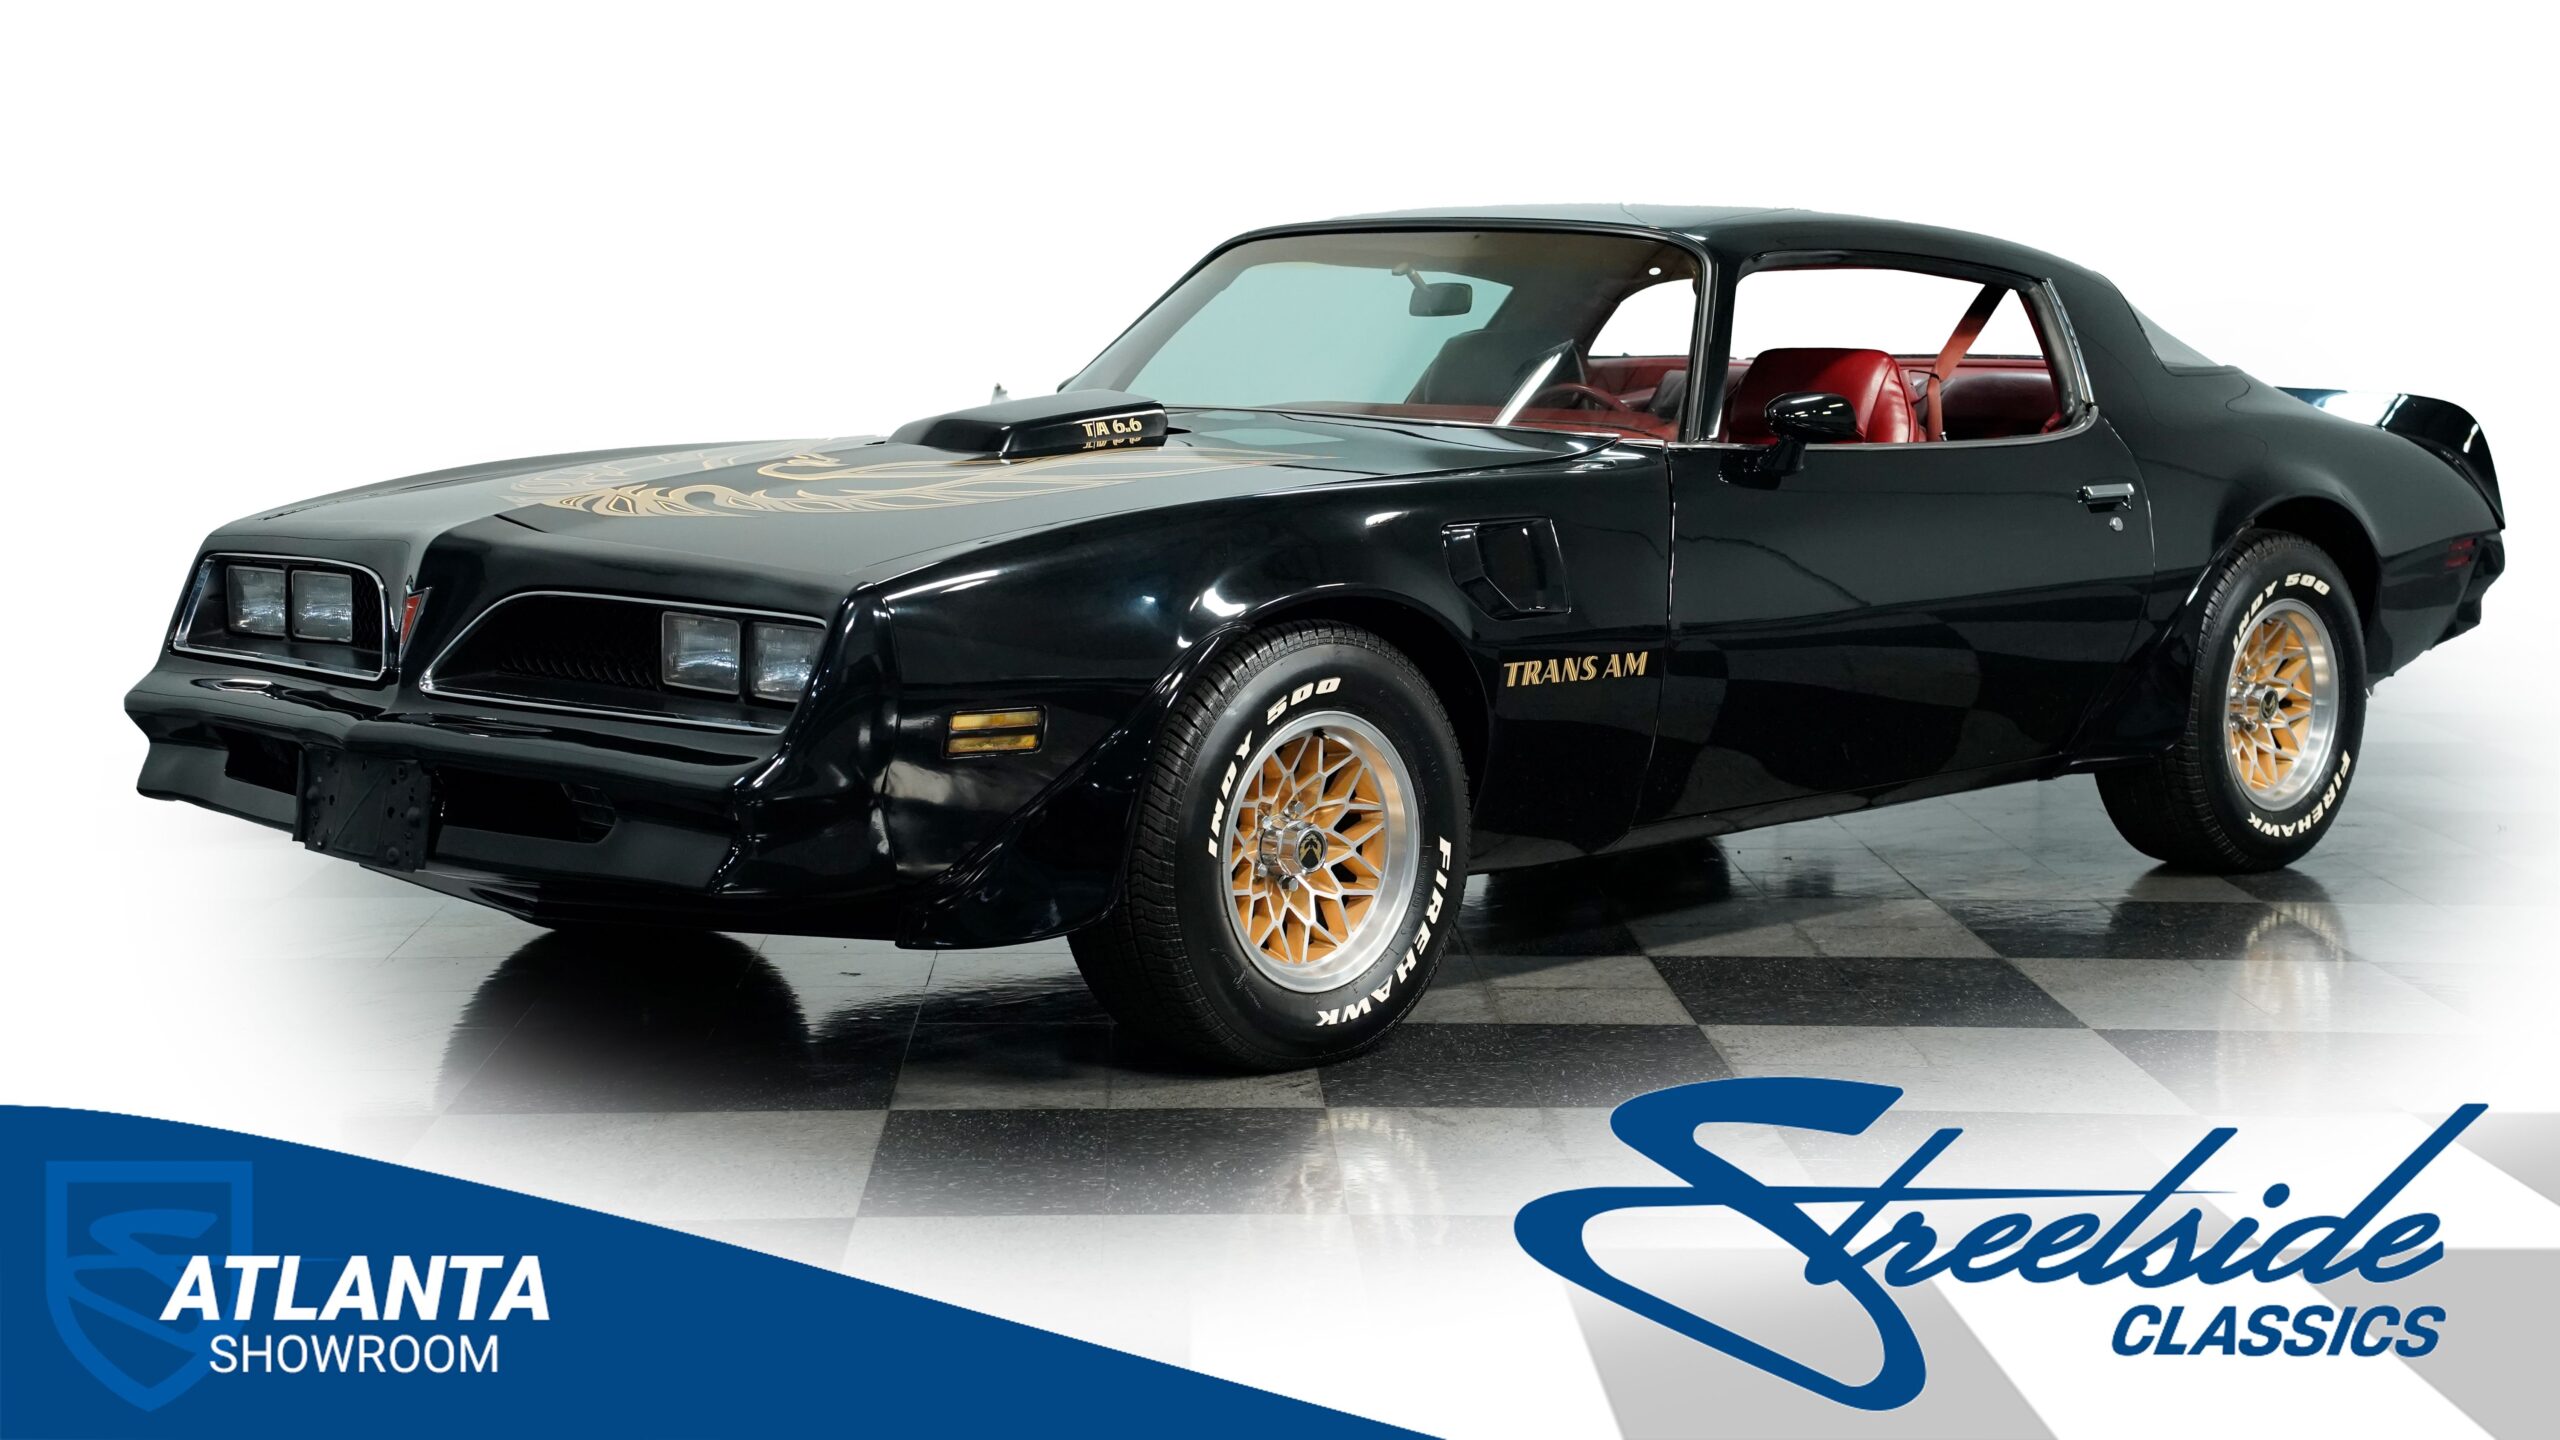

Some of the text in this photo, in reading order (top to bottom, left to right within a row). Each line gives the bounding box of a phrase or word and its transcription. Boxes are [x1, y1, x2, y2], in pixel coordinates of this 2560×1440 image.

[1112, 417, 1143, 434] 6.6
[2233, 573, 2330, 652] INDY 500
[1503, 651, 1649, 688] TRANS AM
[1208, 677, 1342, 858] INDY 500
[2247, 750, 2351, 838] FIREHAWK
[1316, 835, 1452, 1027] FIREHAWK
